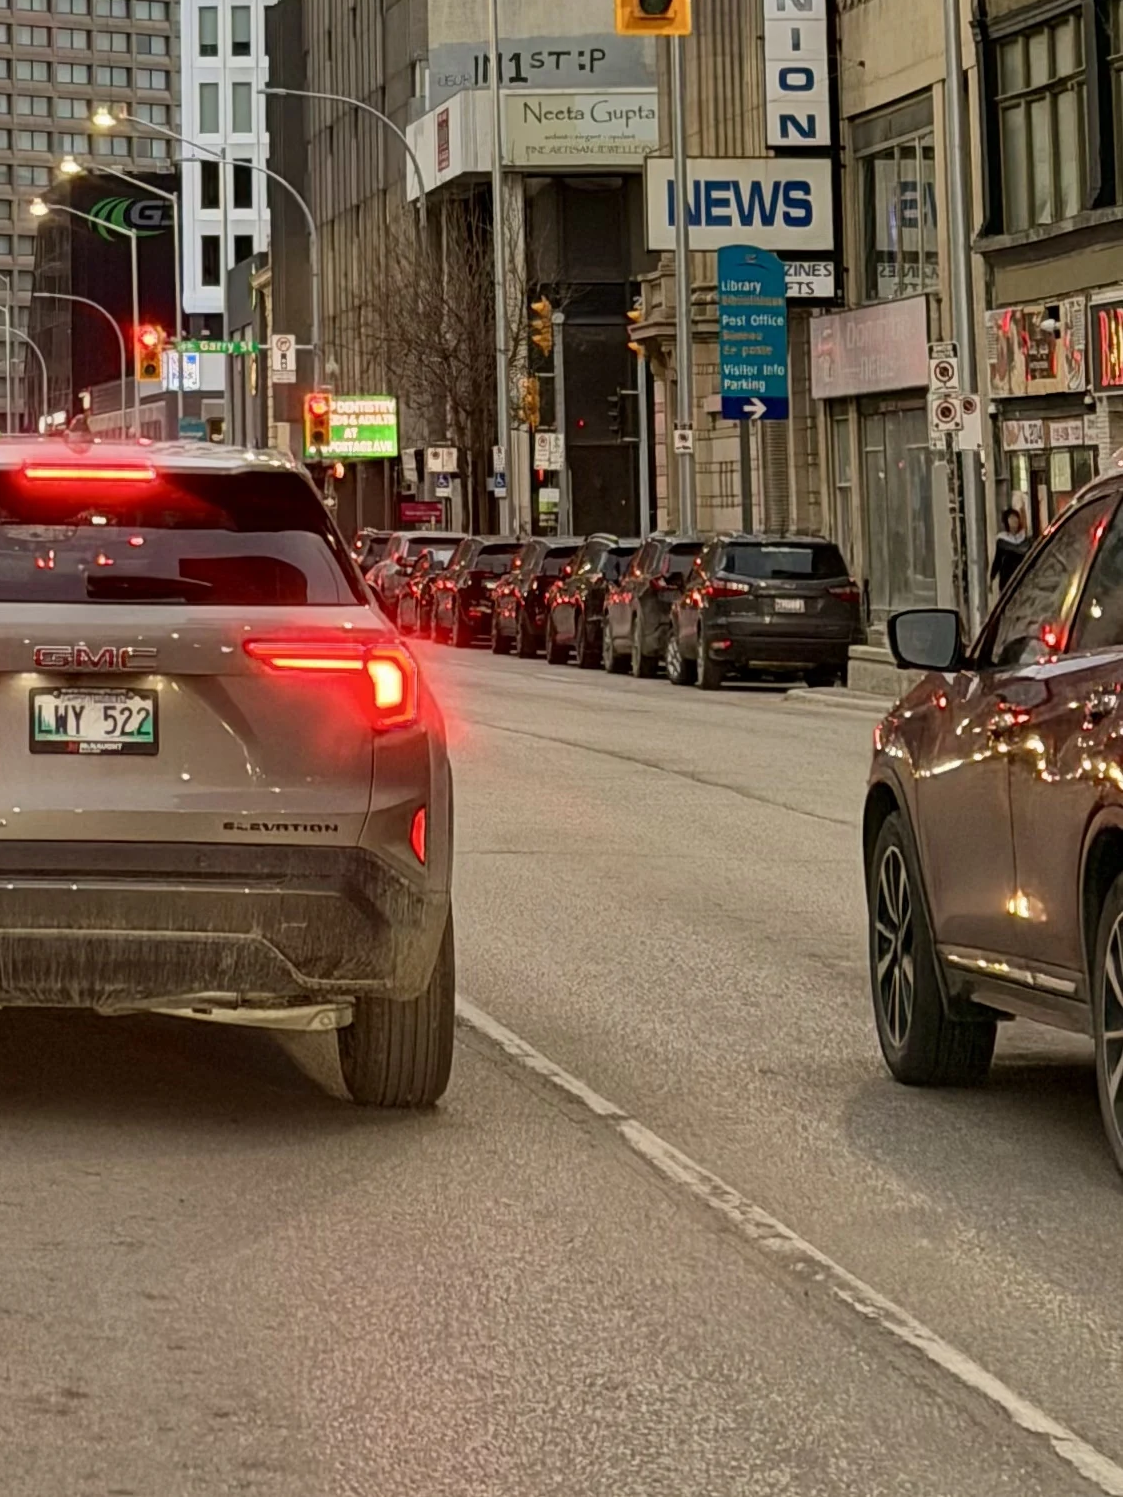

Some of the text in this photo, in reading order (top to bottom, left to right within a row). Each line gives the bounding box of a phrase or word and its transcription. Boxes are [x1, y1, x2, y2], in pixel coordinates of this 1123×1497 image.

[523, 100, 656, 128] Neeta Gupta
[667, 179, 813, 228] NEWS
[784, 263, 833, 278] ZINES
[721, 280, 762, 294] Library
[785, 281, 815, 295] FTS
[722, 314, 785, 327] Post Office
[199, 340, 254, 353] Garry St
[723, 364, 785, 376] Visitor Info
[723, 379, 766, 393] Parking
[344, 427, 358, 439] AT
[33, 646, 157, 671] GMC
[37, 704, 151, 736] LWY 522
[222, 821, 339, 833] ELEVATION
